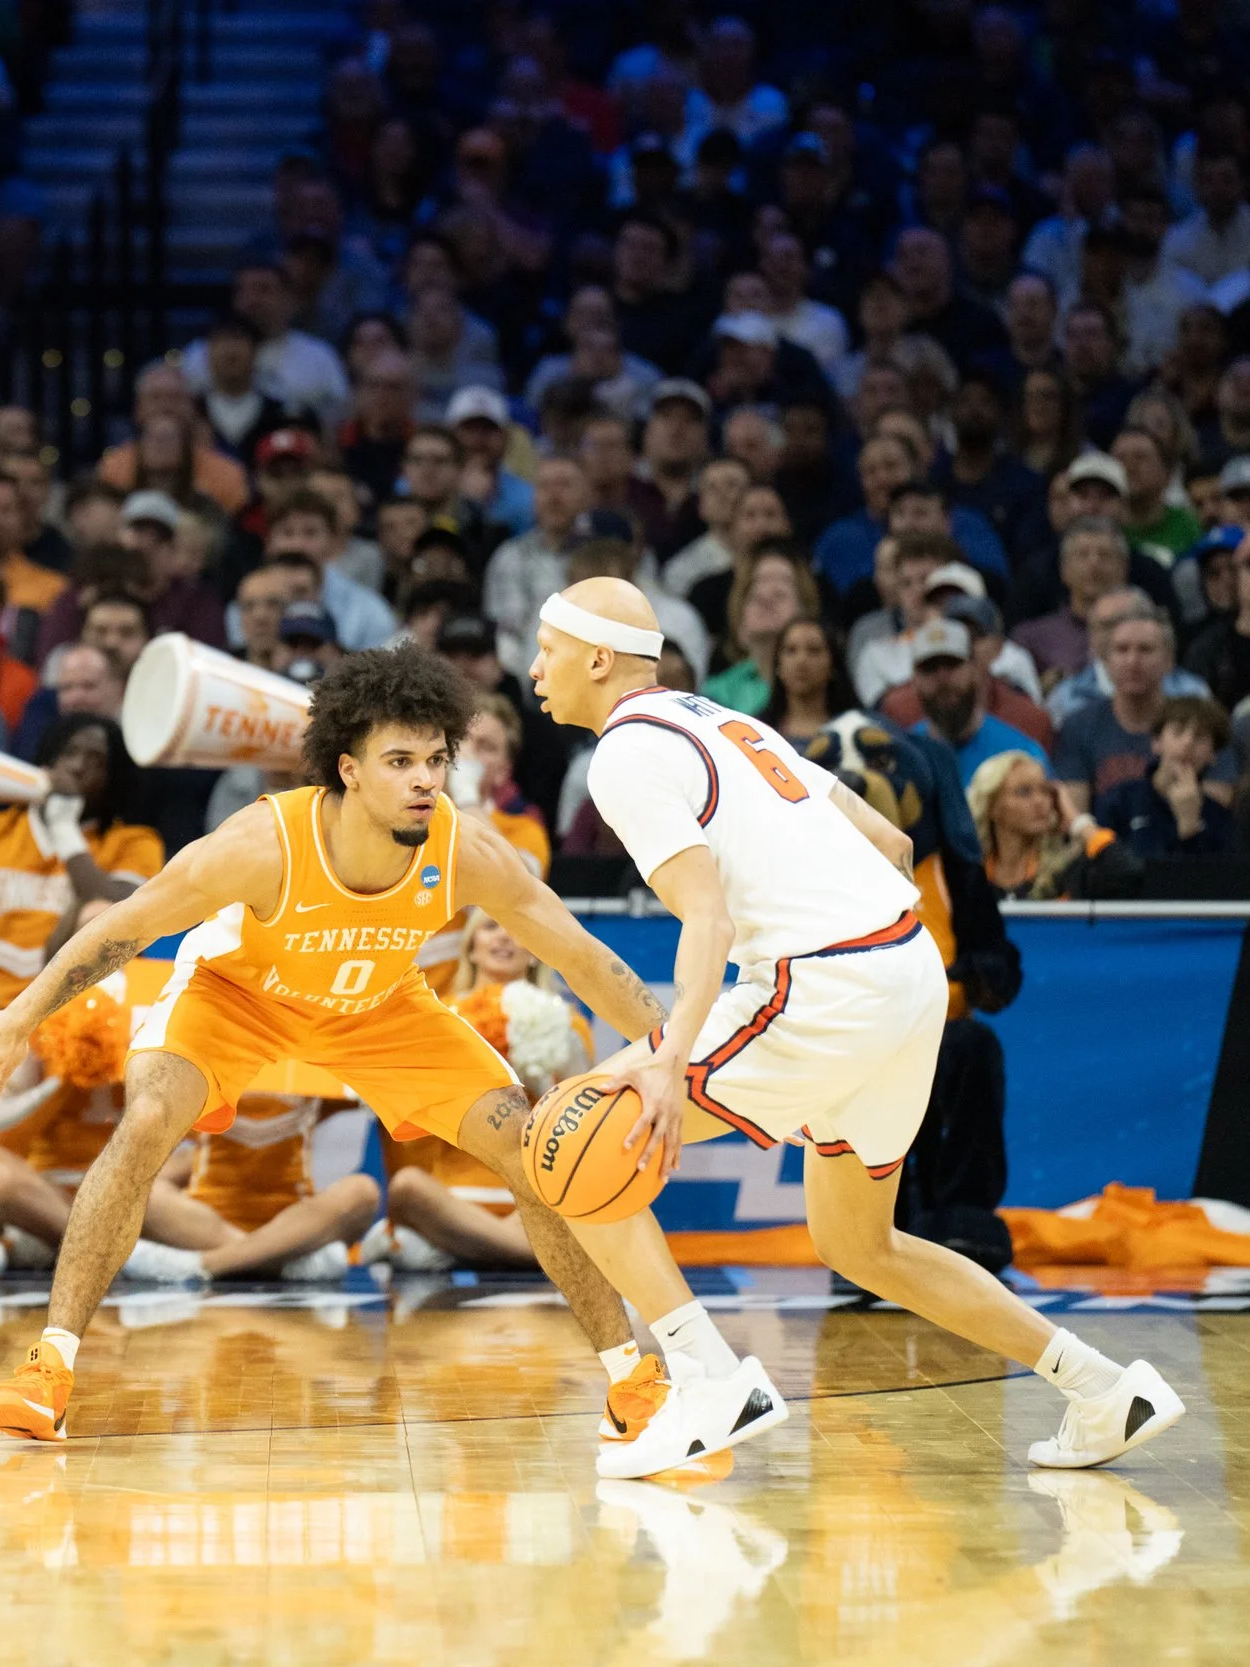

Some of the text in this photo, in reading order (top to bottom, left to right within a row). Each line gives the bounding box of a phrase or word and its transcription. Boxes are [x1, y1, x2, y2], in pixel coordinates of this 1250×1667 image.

[205, 705, 300, 747] TENNE
[718, 720, 810, 804] 6
[262, 964, 402, 1015] VOUNTEE
[330, 960, 376, 995] 0
[541, 1086, 607, 1172] Wilson
